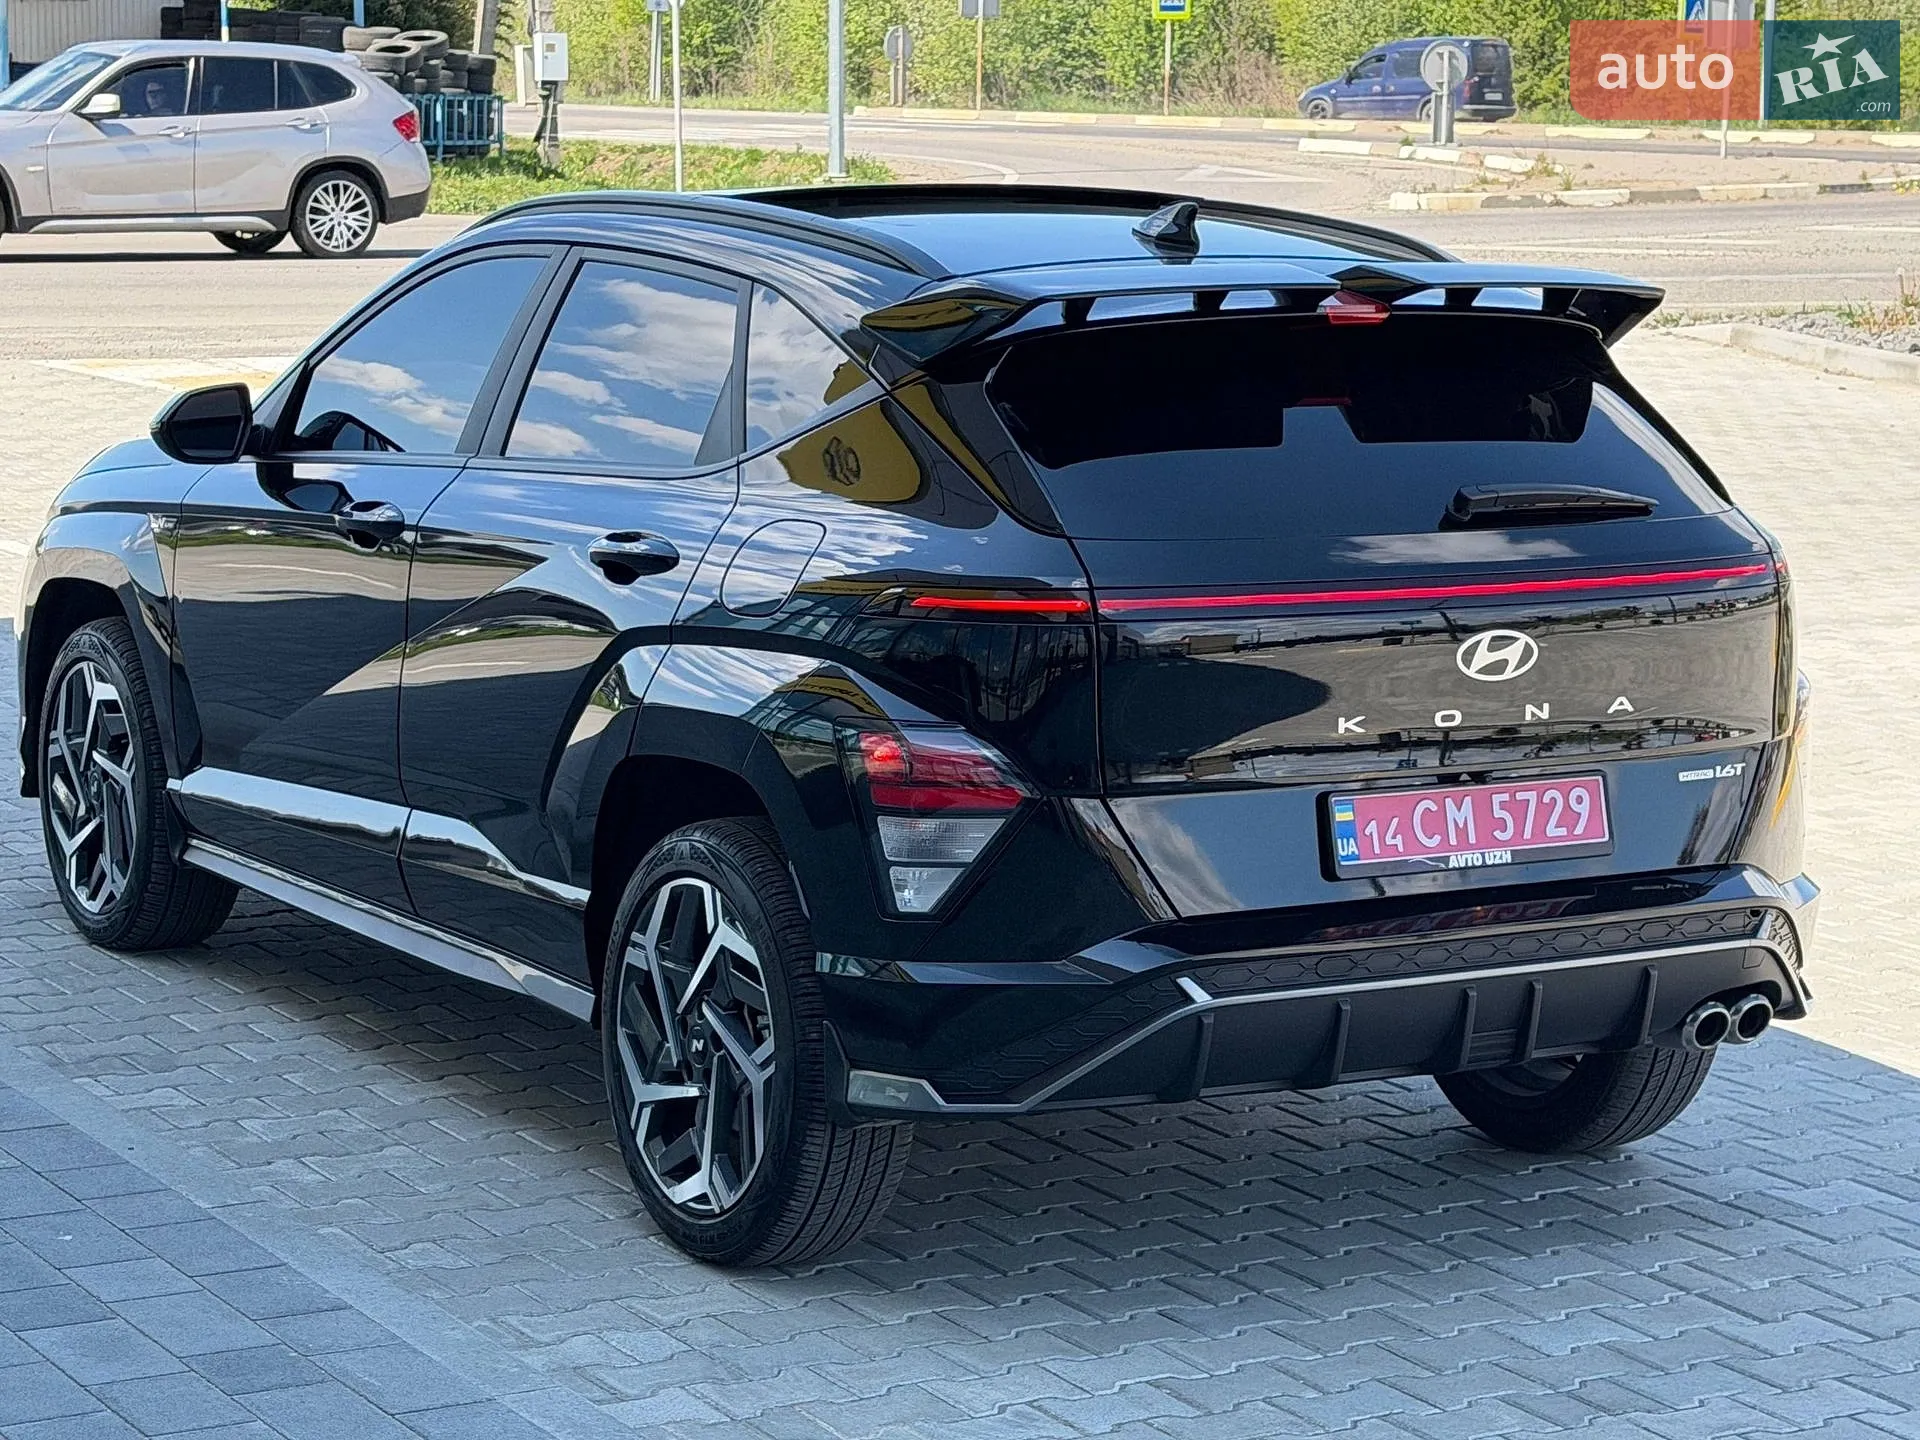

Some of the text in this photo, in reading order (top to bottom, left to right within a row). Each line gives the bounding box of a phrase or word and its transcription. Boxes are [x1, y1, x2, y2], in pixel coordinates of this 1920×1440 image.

[1338, 697, 1634, 734] KONA
[1491, 786, 1590, 841] 5729
[1337, 837, 1358, 857] UA
[1448, 850, 1512, 869] AVTO UZH
